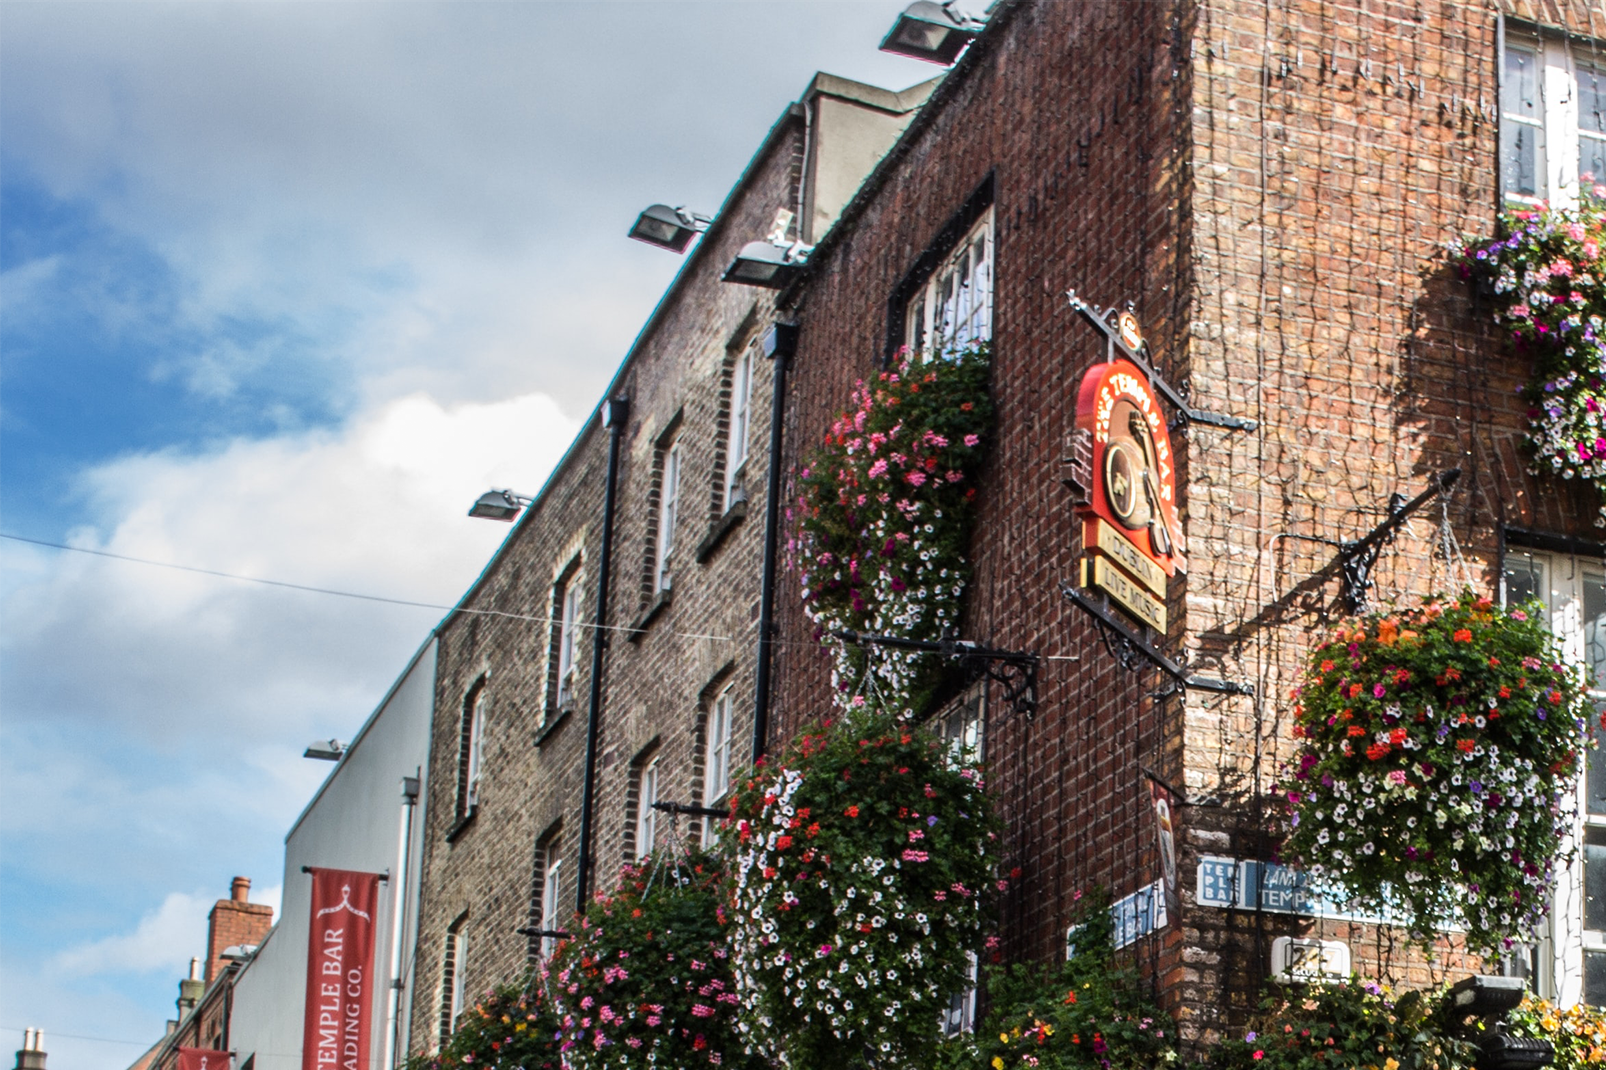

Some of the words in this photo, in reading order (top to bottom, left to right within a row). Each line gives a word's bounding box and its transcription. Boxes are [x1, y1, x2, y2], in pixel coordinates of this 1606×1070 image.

[1112, 534, 1152, 584] DUBLIN
[1104, 567, 1128, 601] LIVE
[1128, 584, 1161, 626] MUSIC
[322, 927, 345, 977] BAR
[346, 965, 363, 997] CO.
